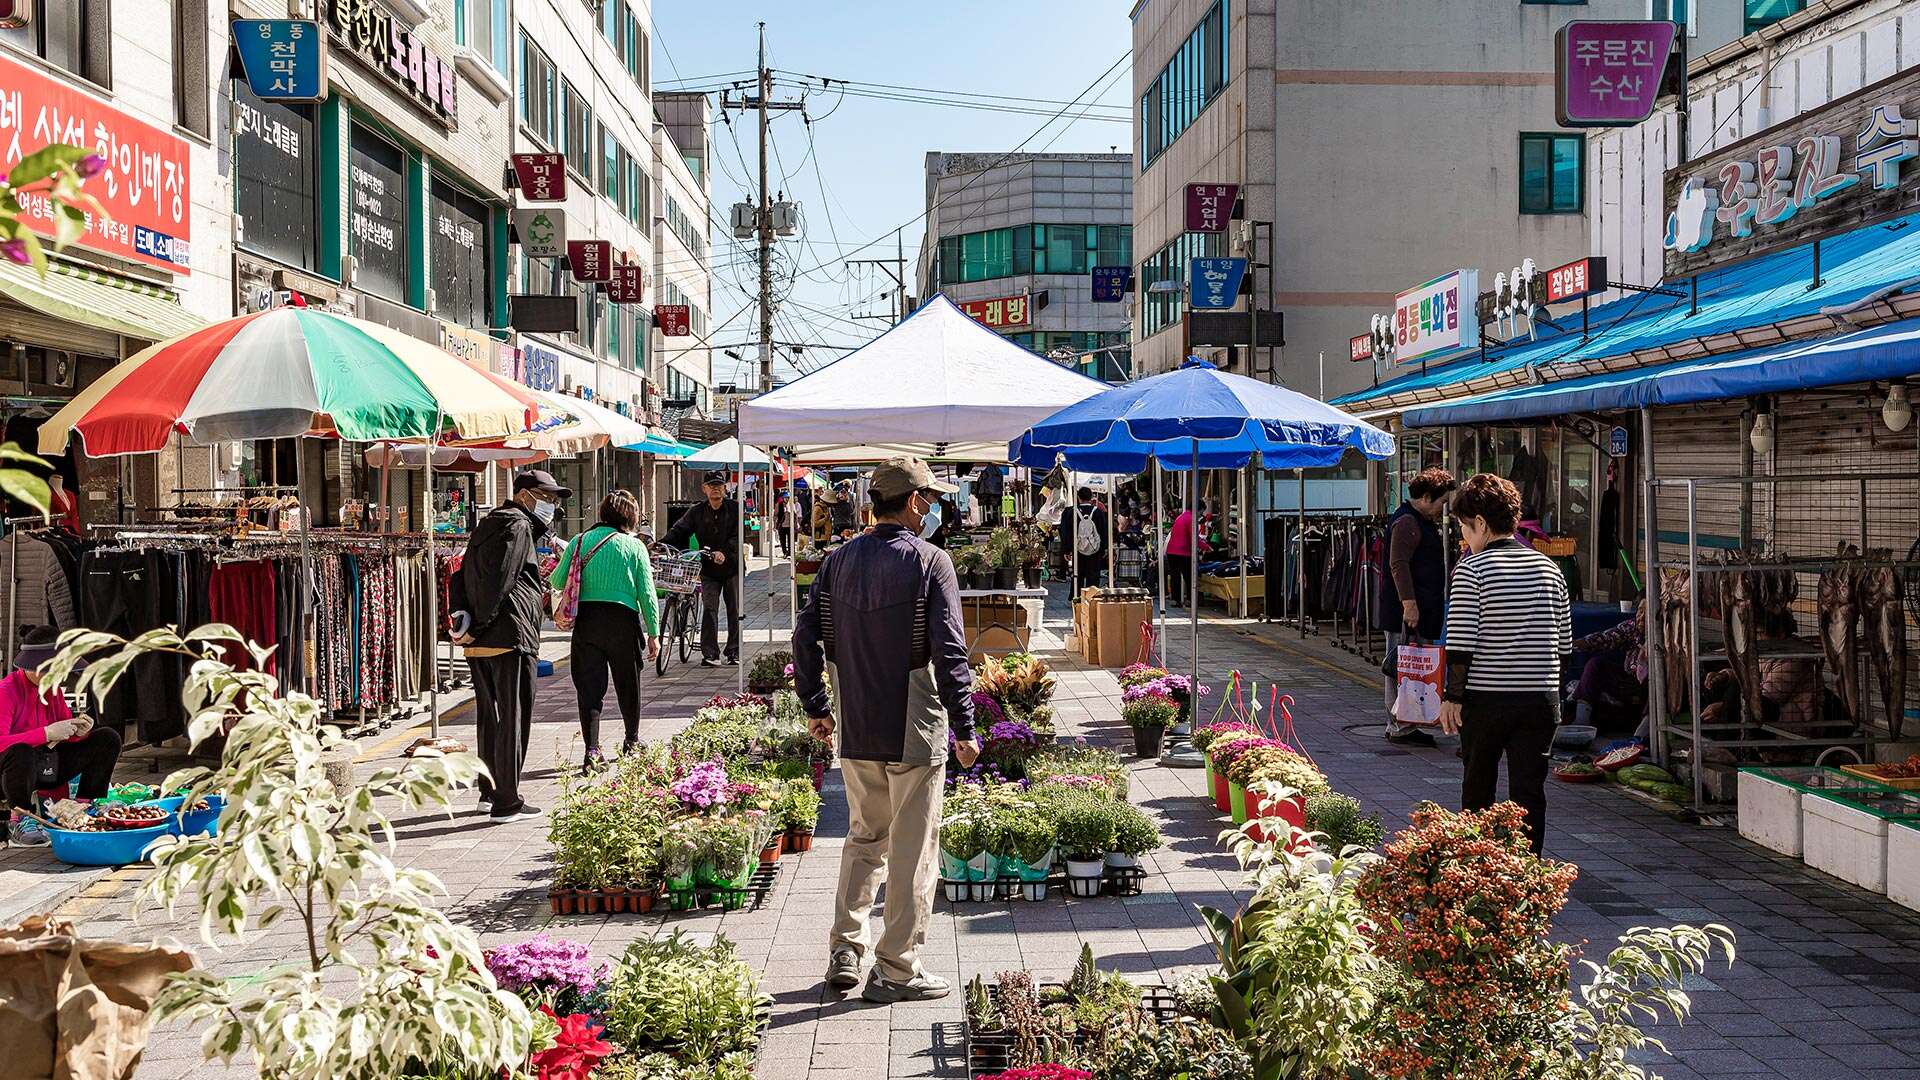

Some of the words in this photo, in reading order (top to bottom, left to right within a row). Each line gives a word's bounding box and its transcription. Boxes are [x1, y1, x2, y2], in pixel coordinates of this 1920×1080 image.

[269, 41, 297, 93] 천막사
[1575, 39, 1654, 66] 주문진
[1589, 75, 1643, 101] 수산
[264, 114, 299, 158] 노래클럽
[94, 120, 184, 223] 할인매장
[519, 155, 558, 165] 국제
[533, 165, 551, 199] 미용실
[1195, 186, 1226, 197] 연일
[1201, 197, 1219, 230] 지업사
[1200, 260, 1233, 270] 대양
[1552, 264, 1585, 297] 작업복
[626, 269, 637, 299] 비너스
[1111, 277, 1122, 298] 모자
[1397, 286, 1459, 347] 명동백화점
